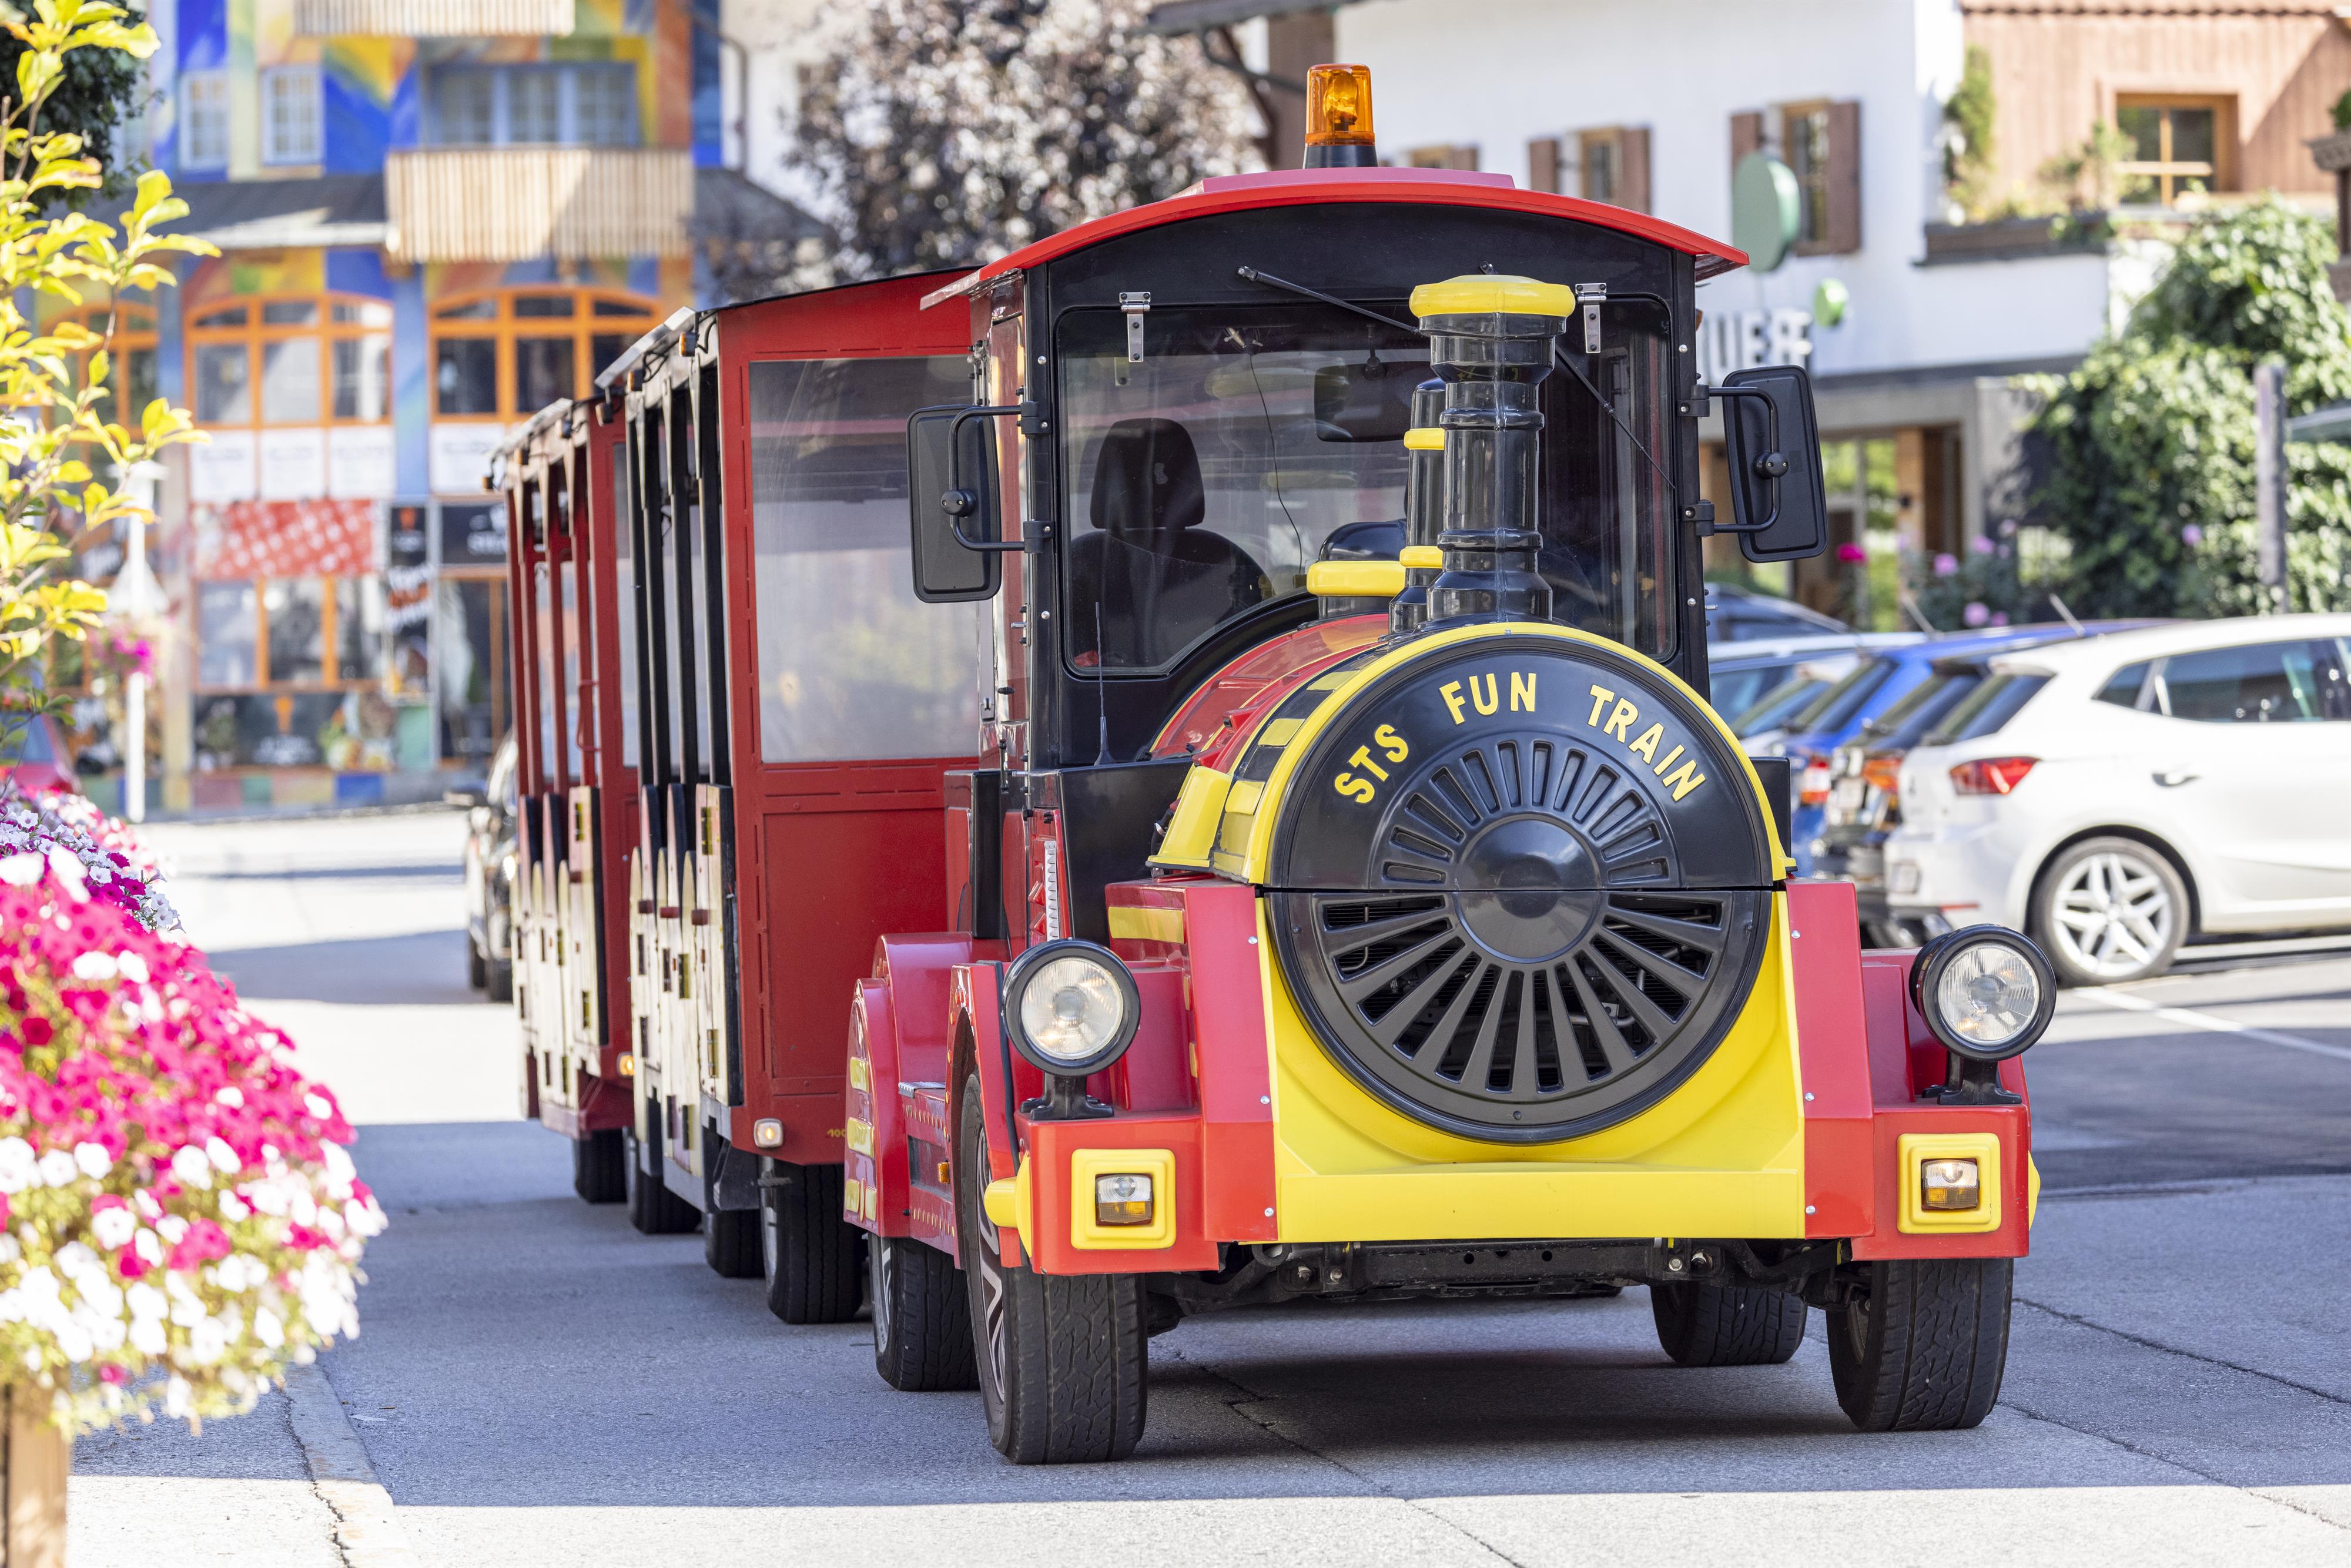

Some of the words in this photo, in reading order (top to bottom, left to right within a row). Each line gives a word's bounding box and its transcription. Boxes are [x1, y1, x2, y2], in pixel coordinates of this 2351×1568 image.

[1334, 723, 1409, 804] STS
[1439, 672, 1536, 726] FUN
[1587, 684, 1707, 802] TRAIN
